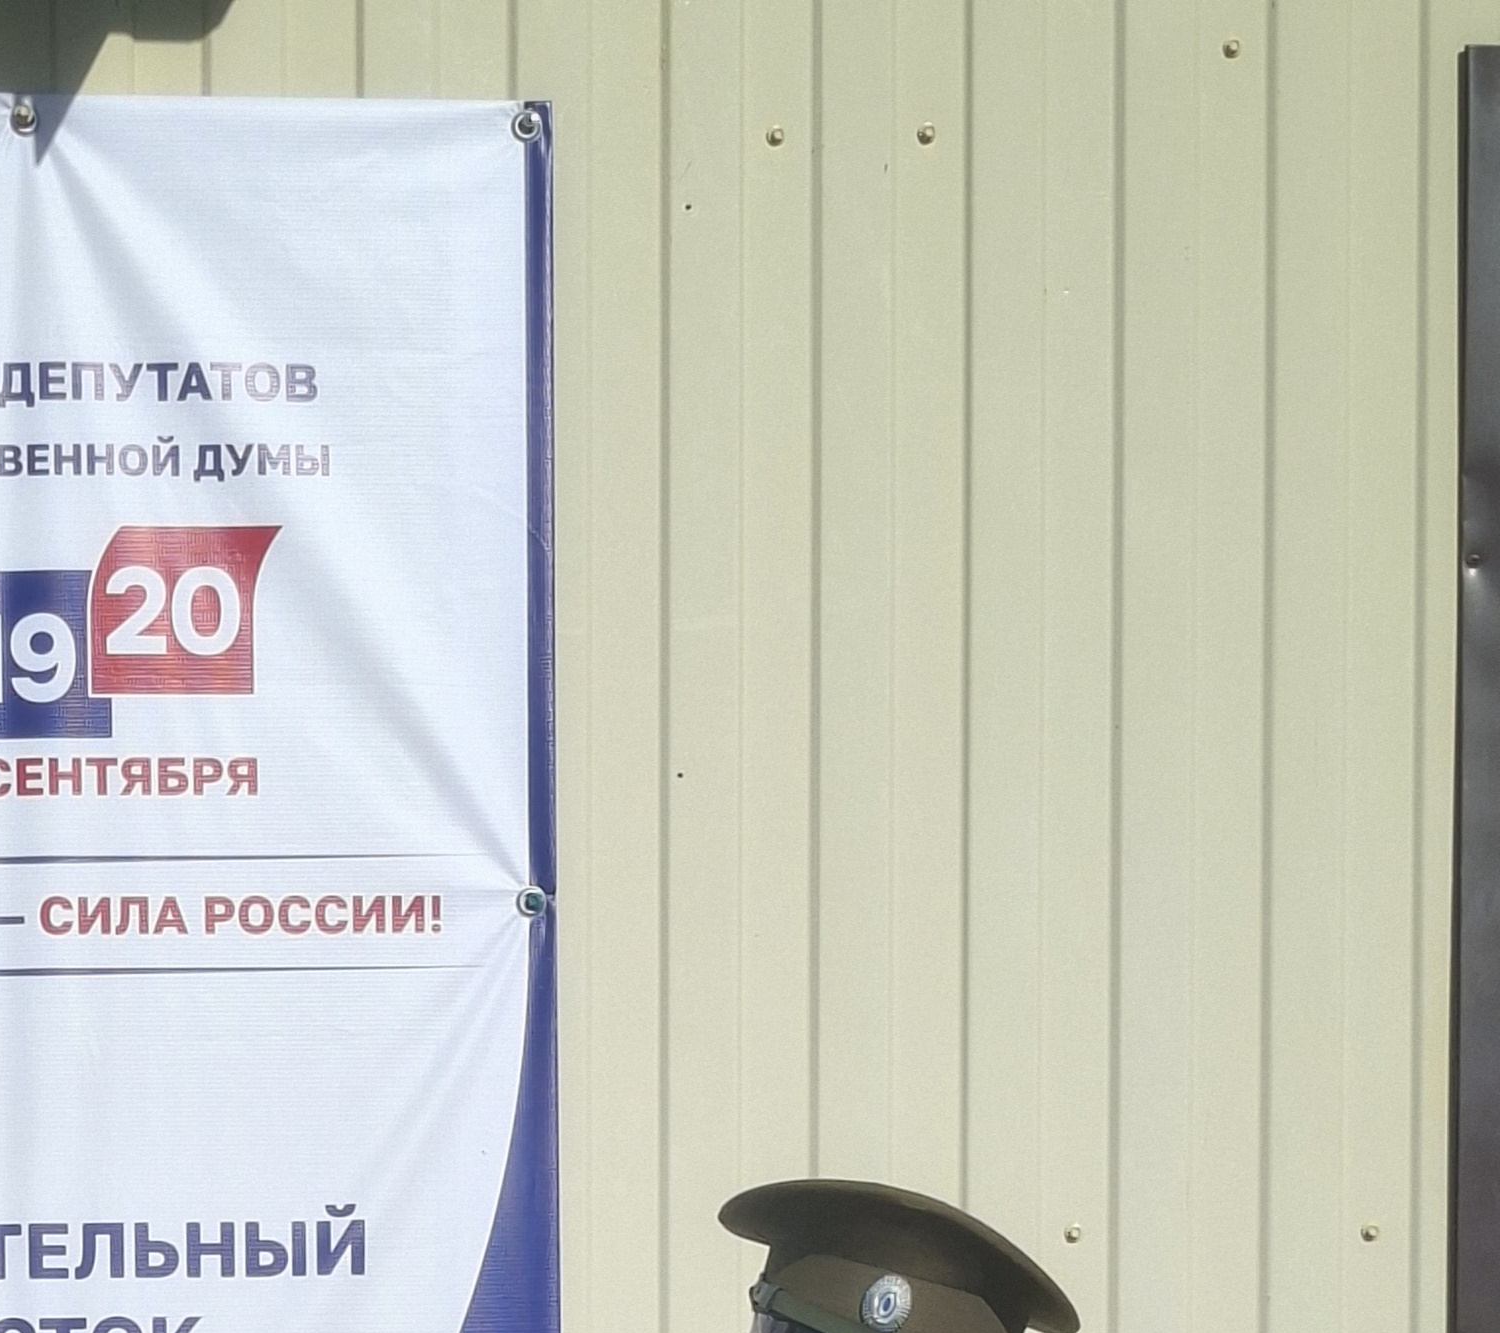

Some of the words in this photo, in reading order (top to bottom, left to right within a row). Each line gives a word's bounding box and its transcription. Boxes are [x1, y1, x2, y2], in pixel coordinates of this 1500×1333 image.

[194, 444, 330, 484] ДУМЫ
[107, 566, 242, 656] 20
[41, 897, 189, 936] СИЛА
[206, 896, 442, 936] РОССИИ!
